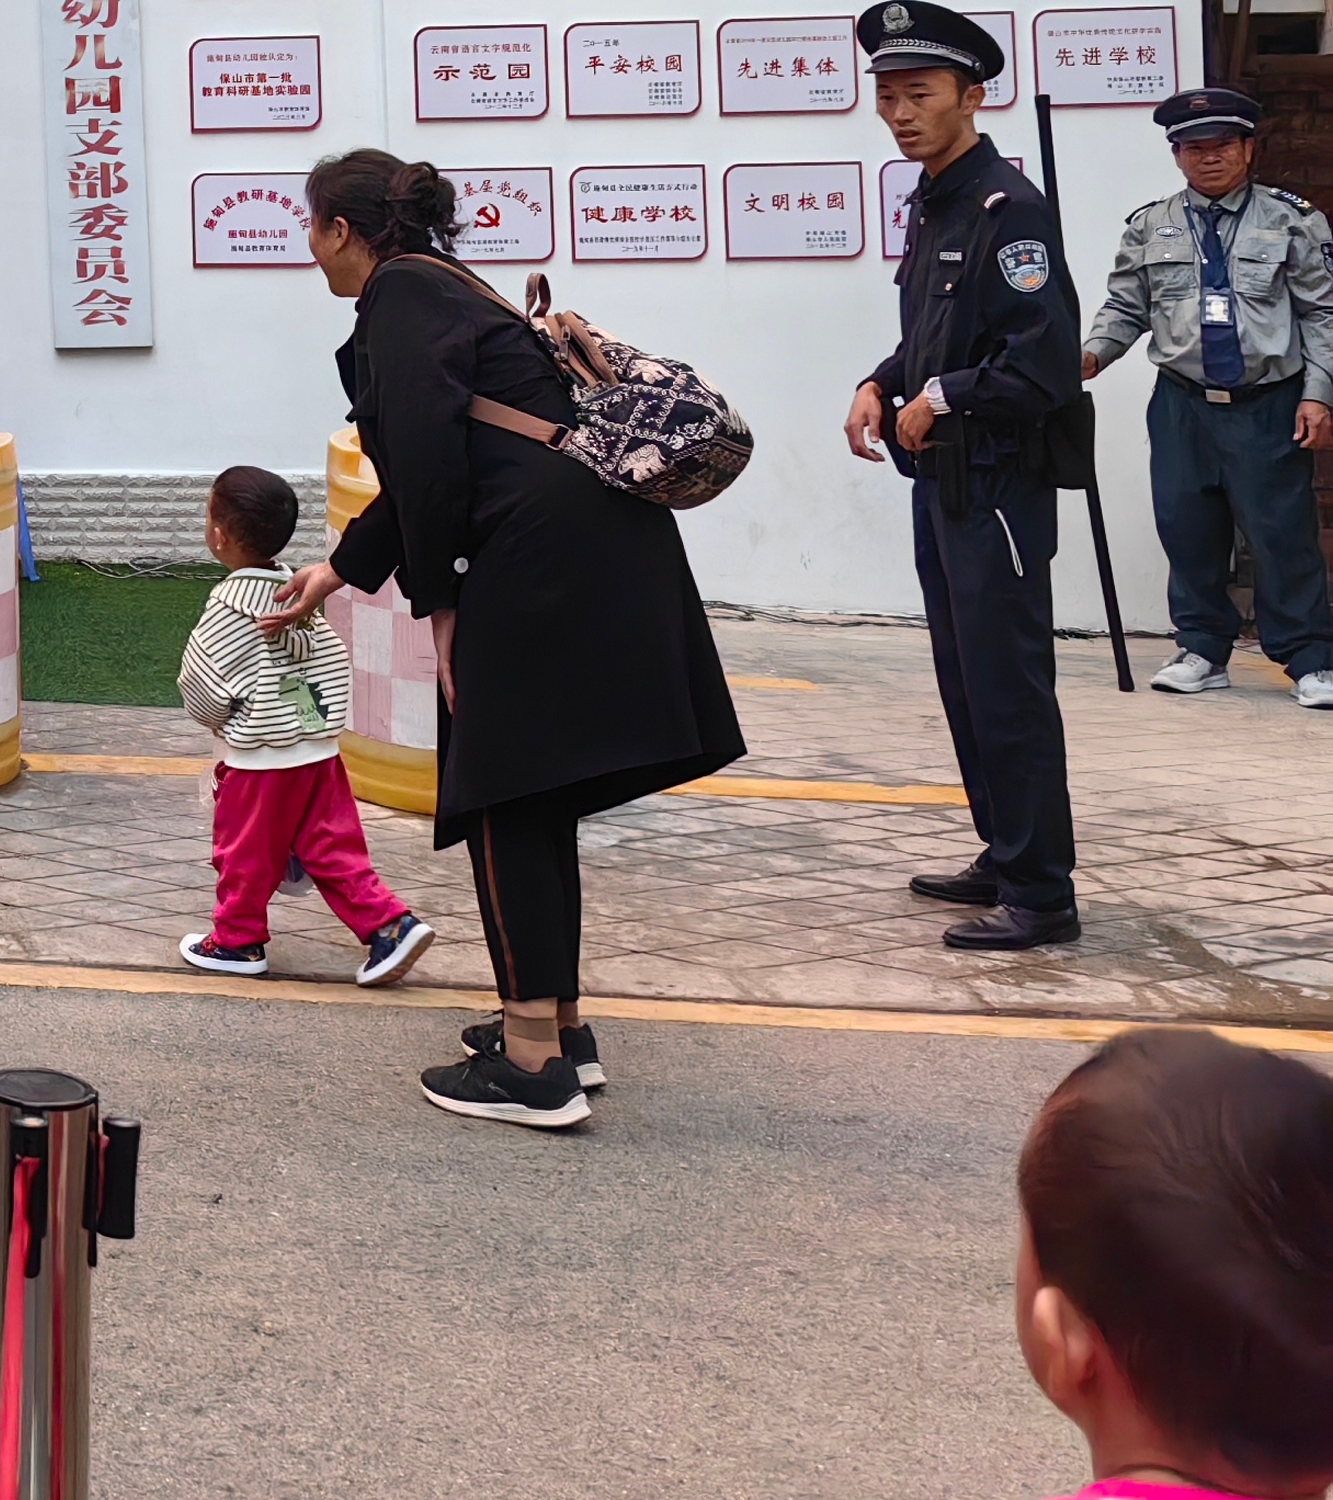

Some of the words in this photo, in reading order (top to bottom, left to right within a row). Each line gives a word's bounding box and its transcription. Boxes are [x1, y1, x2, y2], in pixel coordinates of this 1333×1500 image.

[585, 54, 682, 75] 平安校园
[1055, 45, 1156, 68] 先进学校
[433, 63, 531, 81] 示范园
[737, 57, 839, 79] 先进集体
[220, 72, 292, 83] 保山市第一批
[202, 85, 311, 97] 教育科研基地实验园
[744, 191, 844, 213] 文明校园
[581, 205, 697, 223] 健康学校
[228, 229, 288, 239] 施甸县幼儿园
